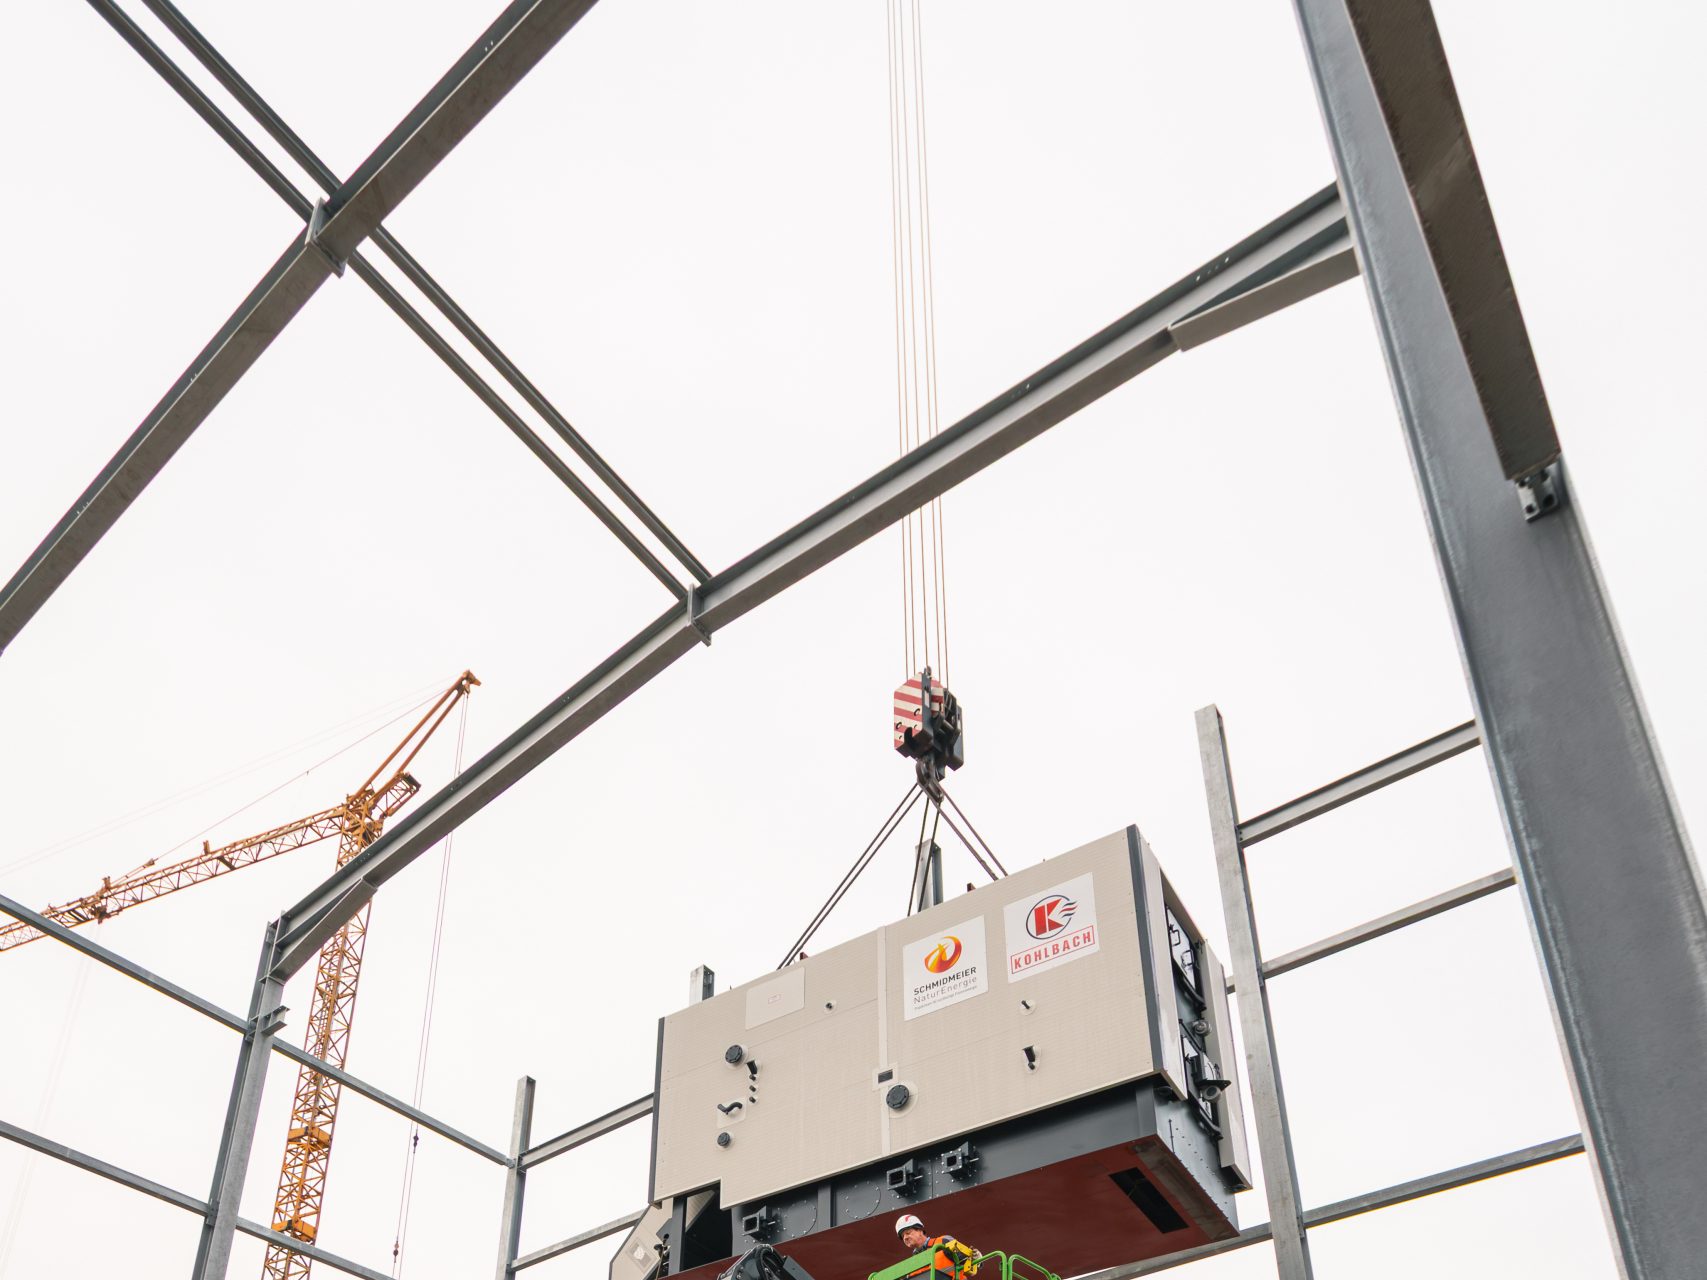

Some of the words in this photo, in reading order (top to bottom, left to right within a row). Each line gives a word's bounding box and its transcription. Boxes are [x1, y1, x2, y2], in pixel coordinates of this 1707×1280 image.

[1013, 931, 1092, 970] KOHLBACH
[913, 966, 977, 996] SCHMIDMEIER
[913, 977, 977, 1004] NaturEnergie
